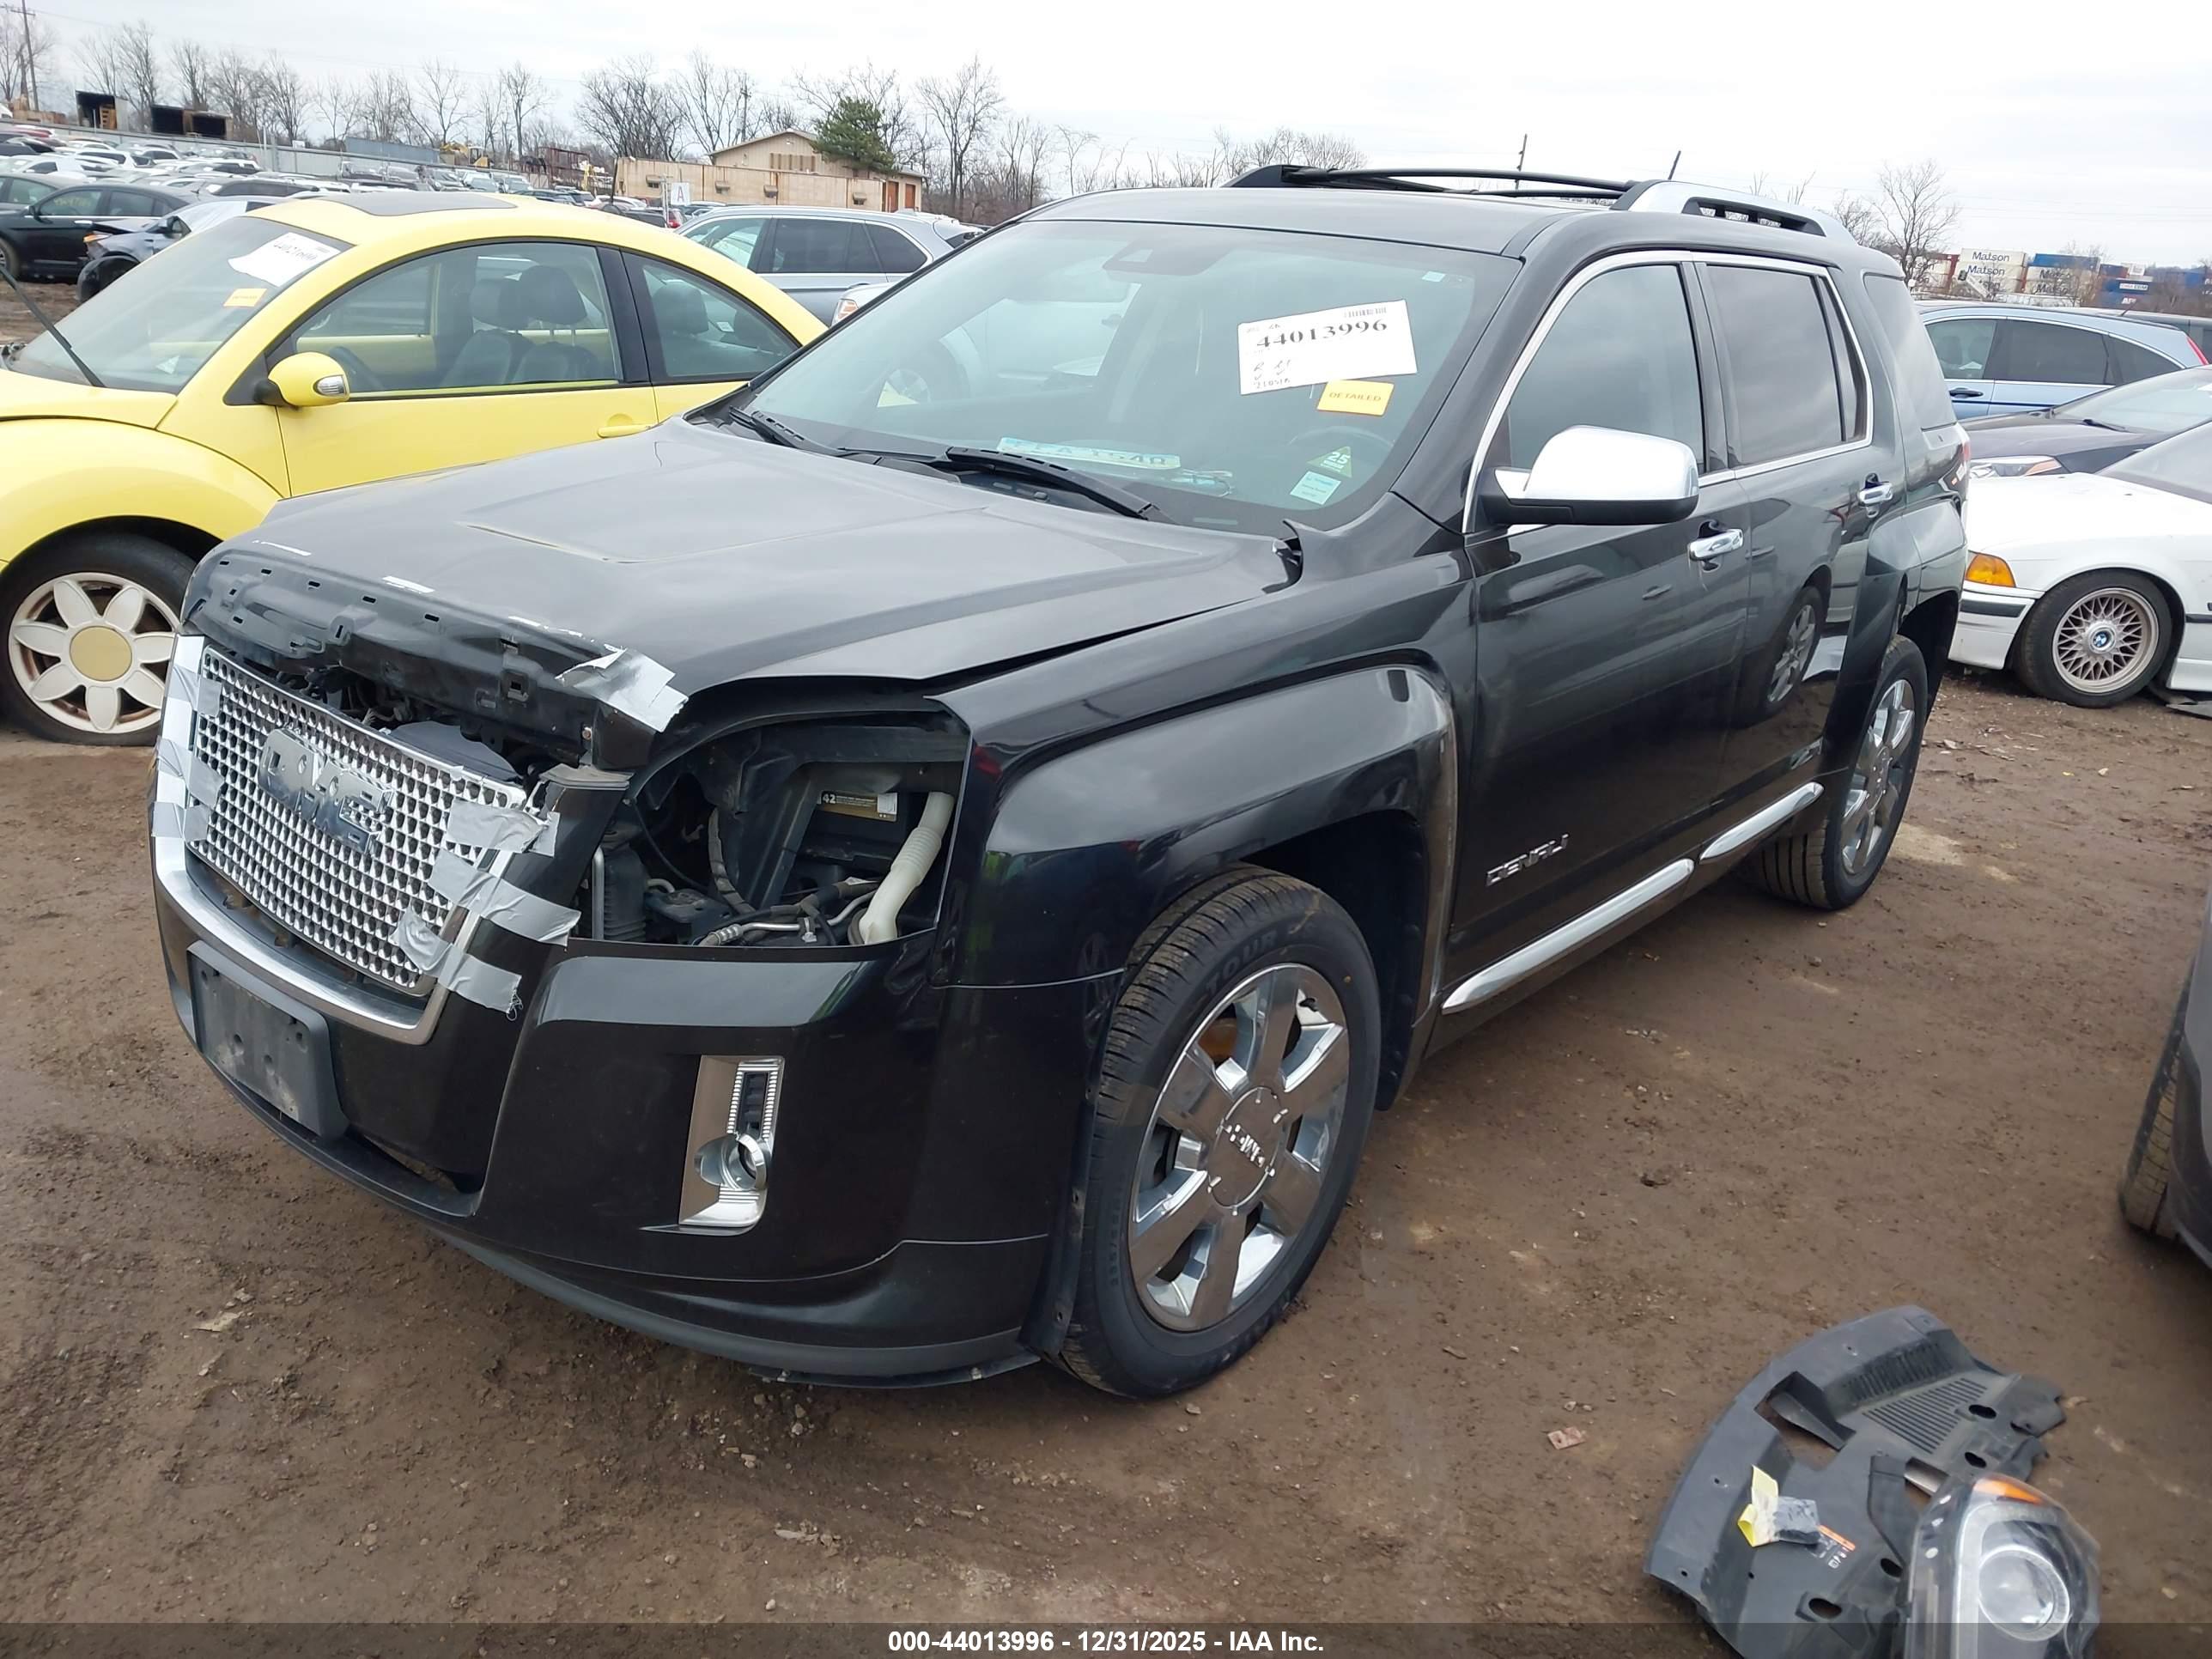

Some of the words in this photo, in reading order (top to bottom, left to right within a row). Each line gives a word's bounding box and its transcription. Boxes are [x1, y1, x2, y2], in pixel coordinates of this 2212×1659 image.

[677, 185, 685, 202] A
[1972, 251, 2010, 262] Matson
[1966, 264, 2005, 276] Matson
[1256, 319, 1388, 348] 44013996
[1328, 391, 1382, 403] DETAILED
[1327, 451, 1351, 465] 25
[822, 793, 836, 805] 42
